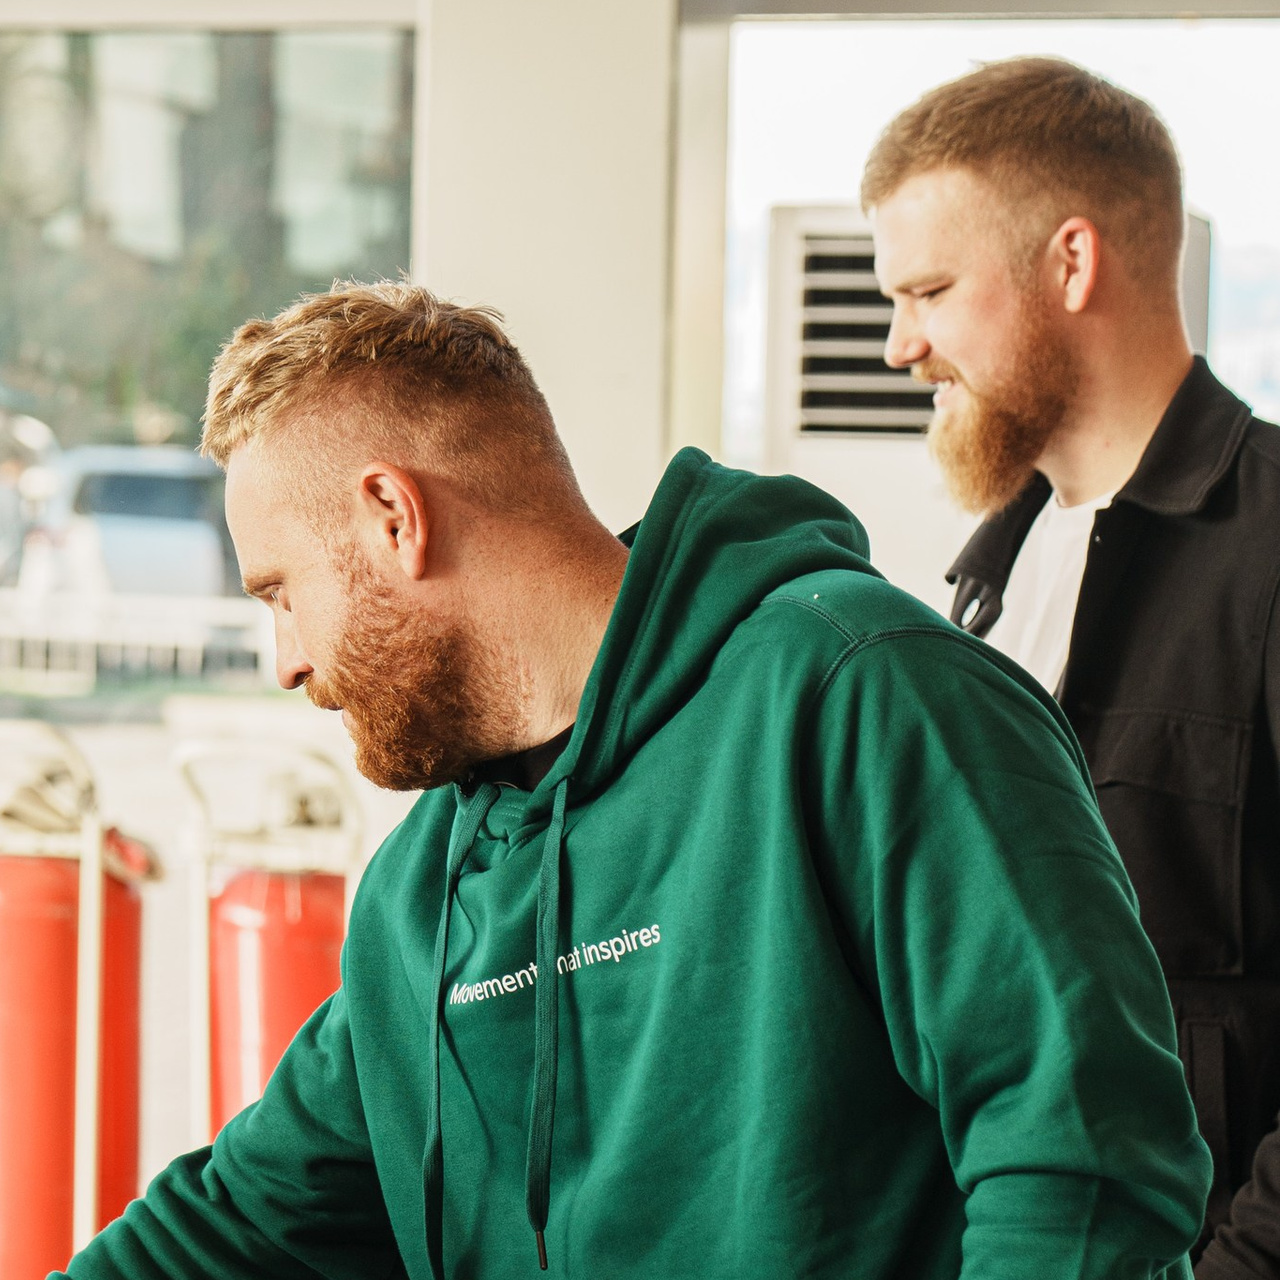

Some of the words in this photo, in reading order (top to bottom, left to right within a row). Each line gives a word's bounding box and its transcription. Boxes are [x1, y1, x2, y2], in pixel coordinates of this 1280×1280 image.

[449, 962, 538, 1005] Movement
[557, 946, 581, 975] hat
[581, 923, 661, 966] inspires
